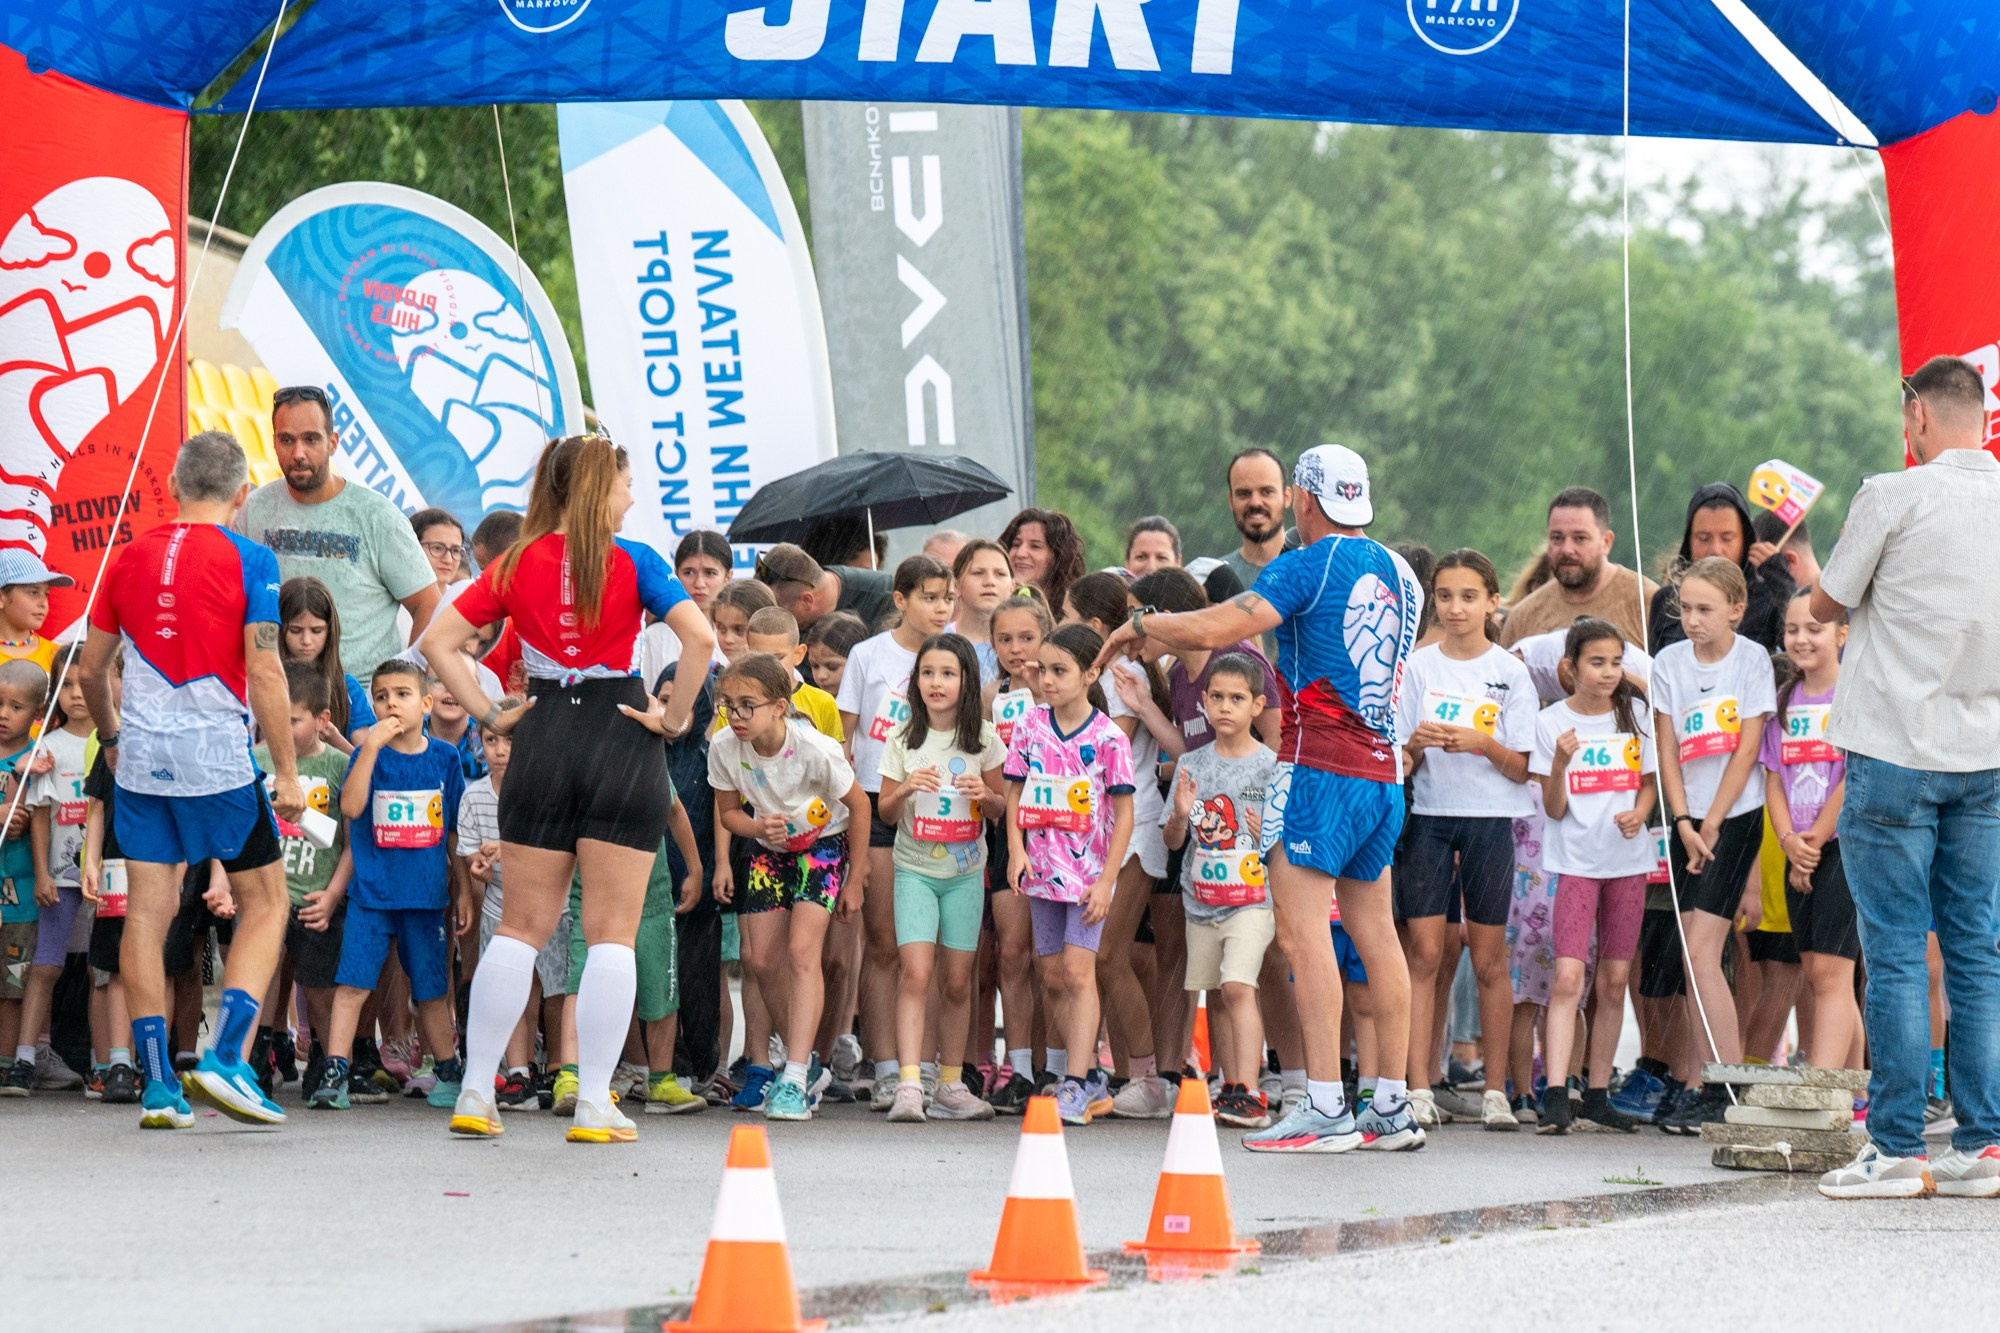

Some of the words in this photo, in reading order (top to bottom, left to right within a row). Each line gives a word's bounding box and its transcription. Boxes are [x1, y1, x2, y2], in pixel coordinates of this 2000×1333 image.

[1425, 15, 1496, 27] MARKOVO
[26, 471, 48, 541] PLOVDIV
[51, 444, 96, 469] HILLS
[105, 444, 121, 456] IN
[50, 490, 141, 527] PLOVDIV
[71, 521, 133, 552] HILLS
[1401, 576, 1417, 662] MATTERS
[1003, 700, 1025, 719] 61
[1434, 702, 1462, 722] 47
[1183, 715, 1208, 738] PUMA
[1684, 712, 1703, 734] 48
[1791, 717, 1810, 737] 97
[1582, 746, 1612, 767] 46
[937, 796, 952, 816] 3
[1034, 785, 1052, 806] 11
[388, 803, 415, 821] 81
[1201, 861, 1228, 880] 60
